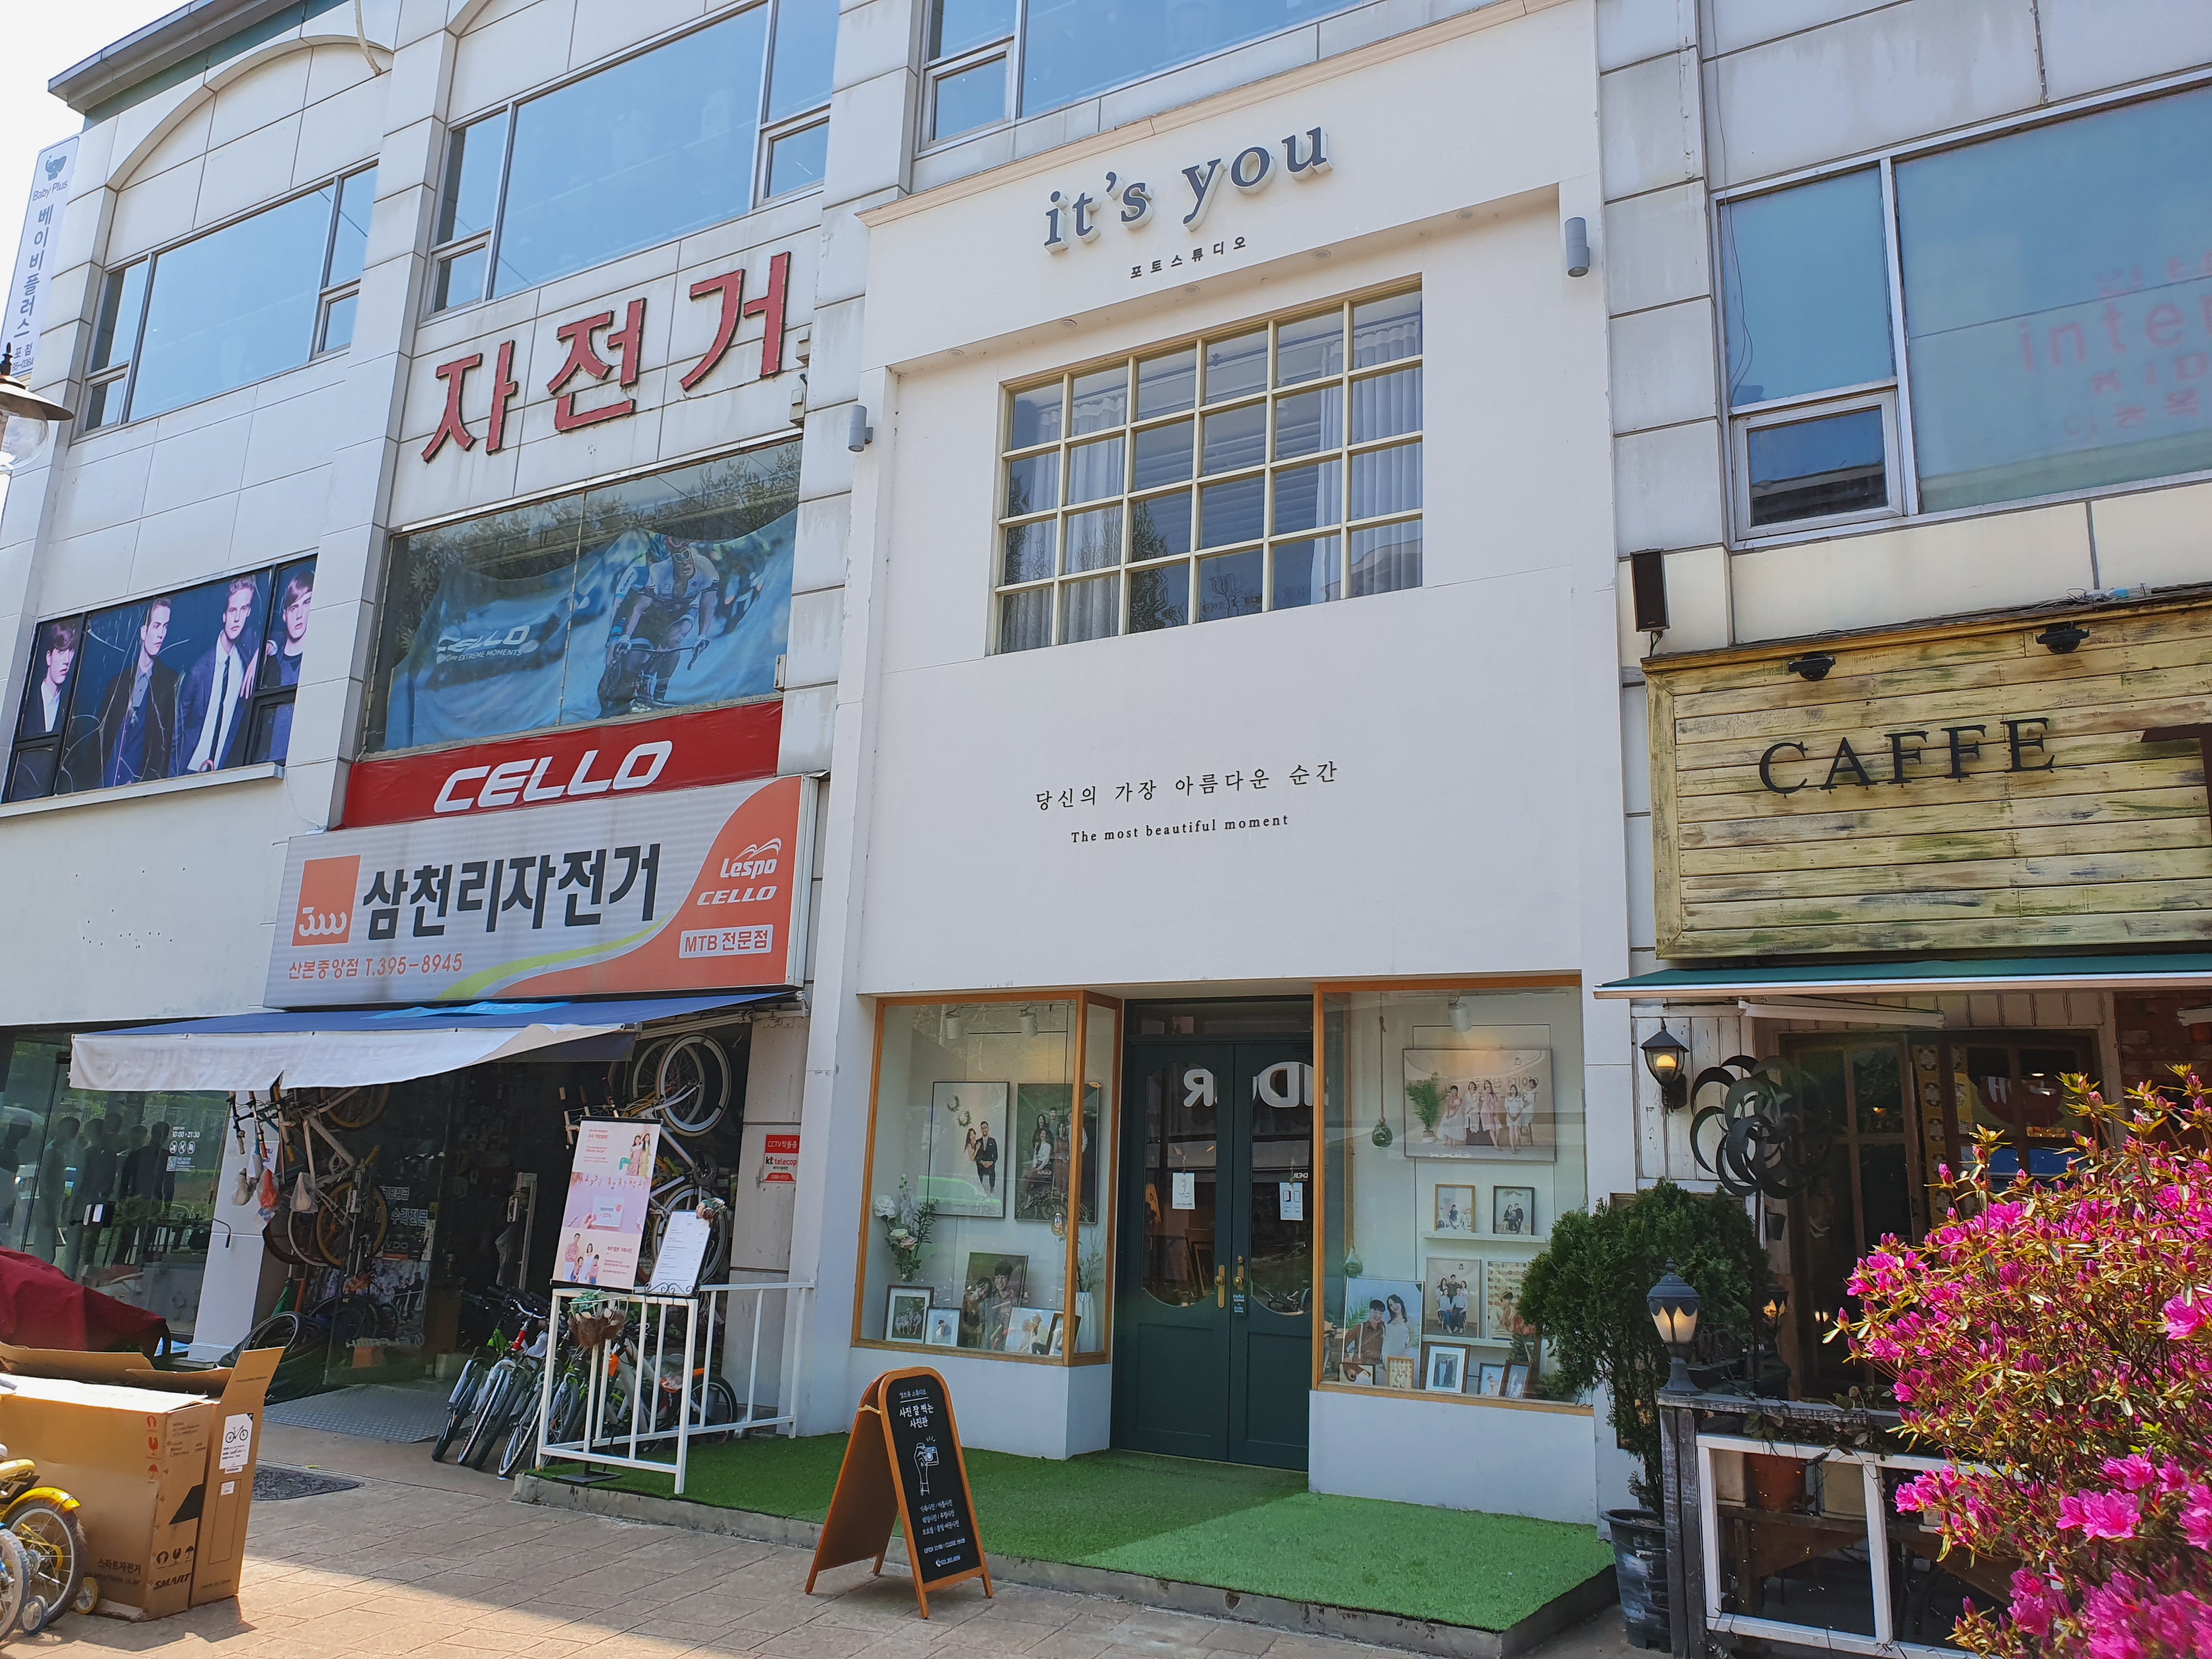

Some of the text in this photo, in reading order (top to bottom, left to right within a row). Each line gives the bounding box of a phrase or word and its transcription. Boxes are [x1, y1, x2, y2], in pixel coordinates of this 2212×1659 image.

[32, 180, 68, 202] Baby Plus
[1043, 126, 1331, 252] it's you
[14, 204, 54, 338] 베이비플러스
[1130, 236, 1246, 279] 포토스튜디오
[421, 251, 792, 464] 자전거
[458, 651, 486, 661] EXTREME
[1759, 717, 2056, 794] CAFFE
[434, 740, 673, 813] CELLO
[1036, 761, 1338, 811] 당신의 가장 아름다운 순간
[1071, 815, 1289, 843] The most beautiful moment
[720, 856, 777, 879] Lespo
[362, 843, 662, 940] 삼천리자전거
[697, 885, 777, 906] CELLO
[684, 929, 769, 953] MTB 전문점
[289, 952, 464, 981] 산본중앙점 T.395-8945
[765, 1156, 797, 1167] kt telecop
[899, 1403, 934, 1418] 사진 잘 찍는
[910, 1415, 928, 1429] 사진관
[154, 1572, 192, 1590] SMART
